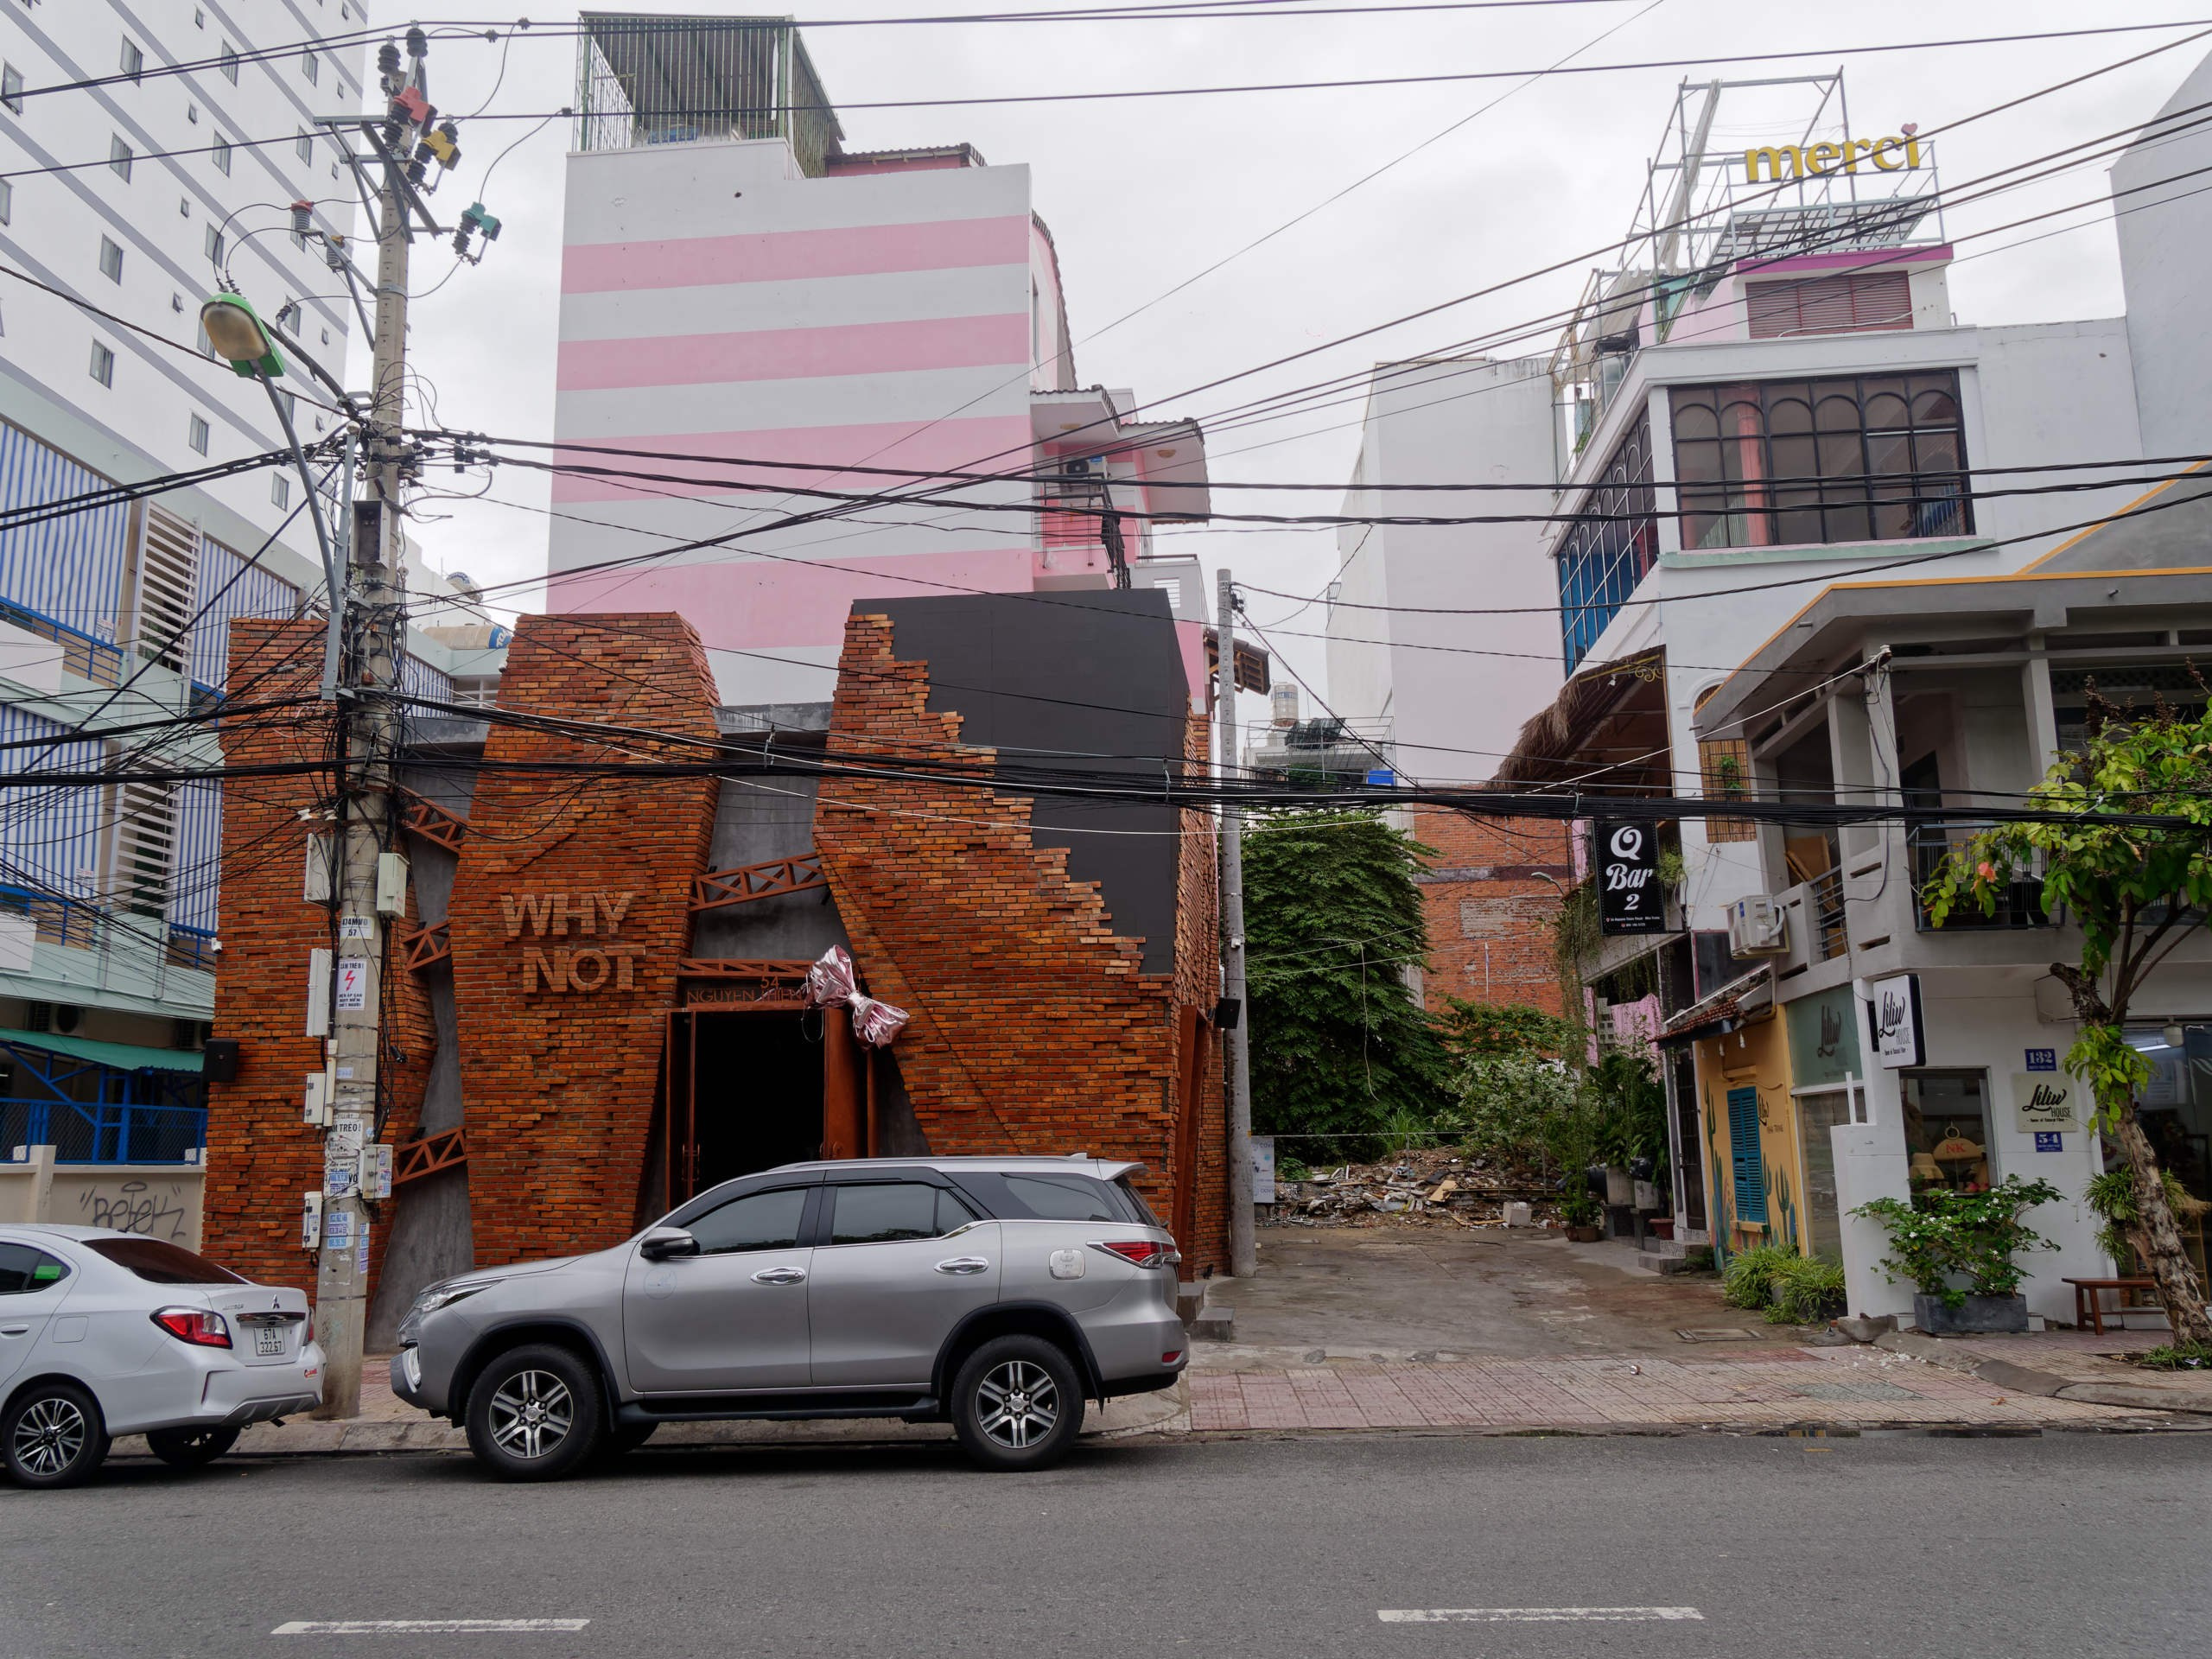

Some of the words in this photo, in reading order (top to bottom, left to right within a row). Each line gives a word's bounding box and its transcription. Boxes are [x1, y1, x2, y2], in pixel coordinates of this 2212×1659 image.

[1745, 130, 1920, 184] merci
[1610, 826, 1643, 861] Q
[1605, 863, 1653, 892] Bar
[1624, 893, 1641, 911] 2
[499, 892, 636, 937] WHY
[523, 946, 645, 993] NOT
[760, 976, 779, 988] 54
[1878, 991, 1906, 1039] Liliw
[2029, 1052, 2053, 1064] 132
[2022, 1084, 2067, 1112] Liliw
[2050, 1106, 2071, 1118] HOUSE
[2038, 1134, 2058, 1144] 54
[264, 1328, 276, 1340] 67A
[259, 1341, 283, 1353] 322.67
